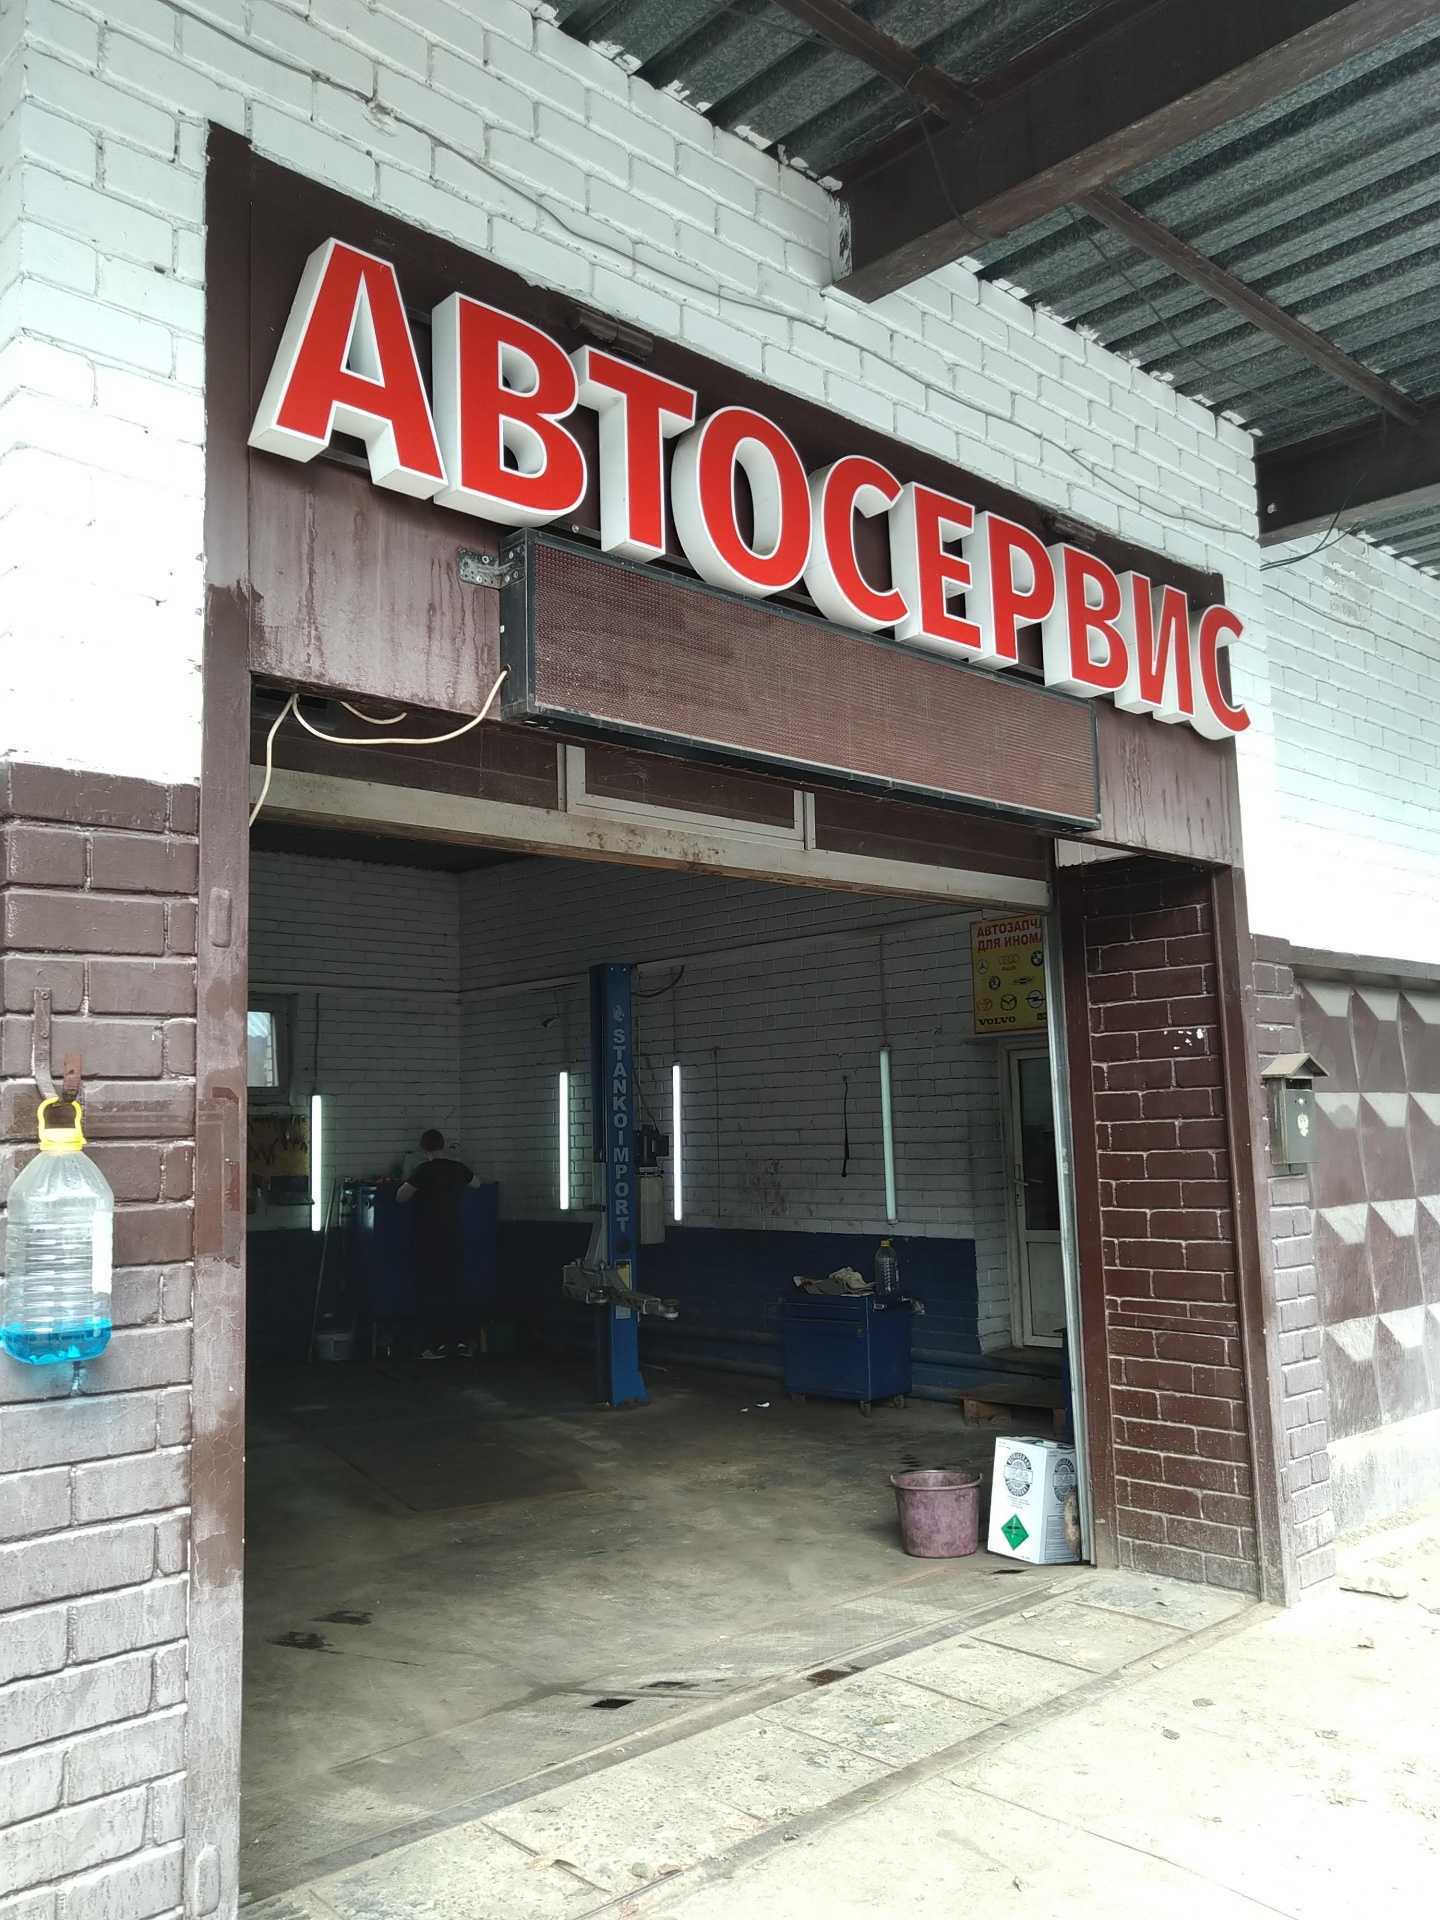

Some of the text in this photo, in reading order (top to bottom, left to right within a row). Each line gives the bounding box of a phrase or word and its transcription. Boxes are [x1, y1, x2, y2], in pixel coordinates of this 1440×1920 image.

[248, 237, 1251, 739] АВТОСЕРВИС
[977, 919, 1041, 938] АВТОЗАПЧ
[978, 938, 1001, 952] ДЛЯ
[979, 1016, 1016, 1026] VOLVO
